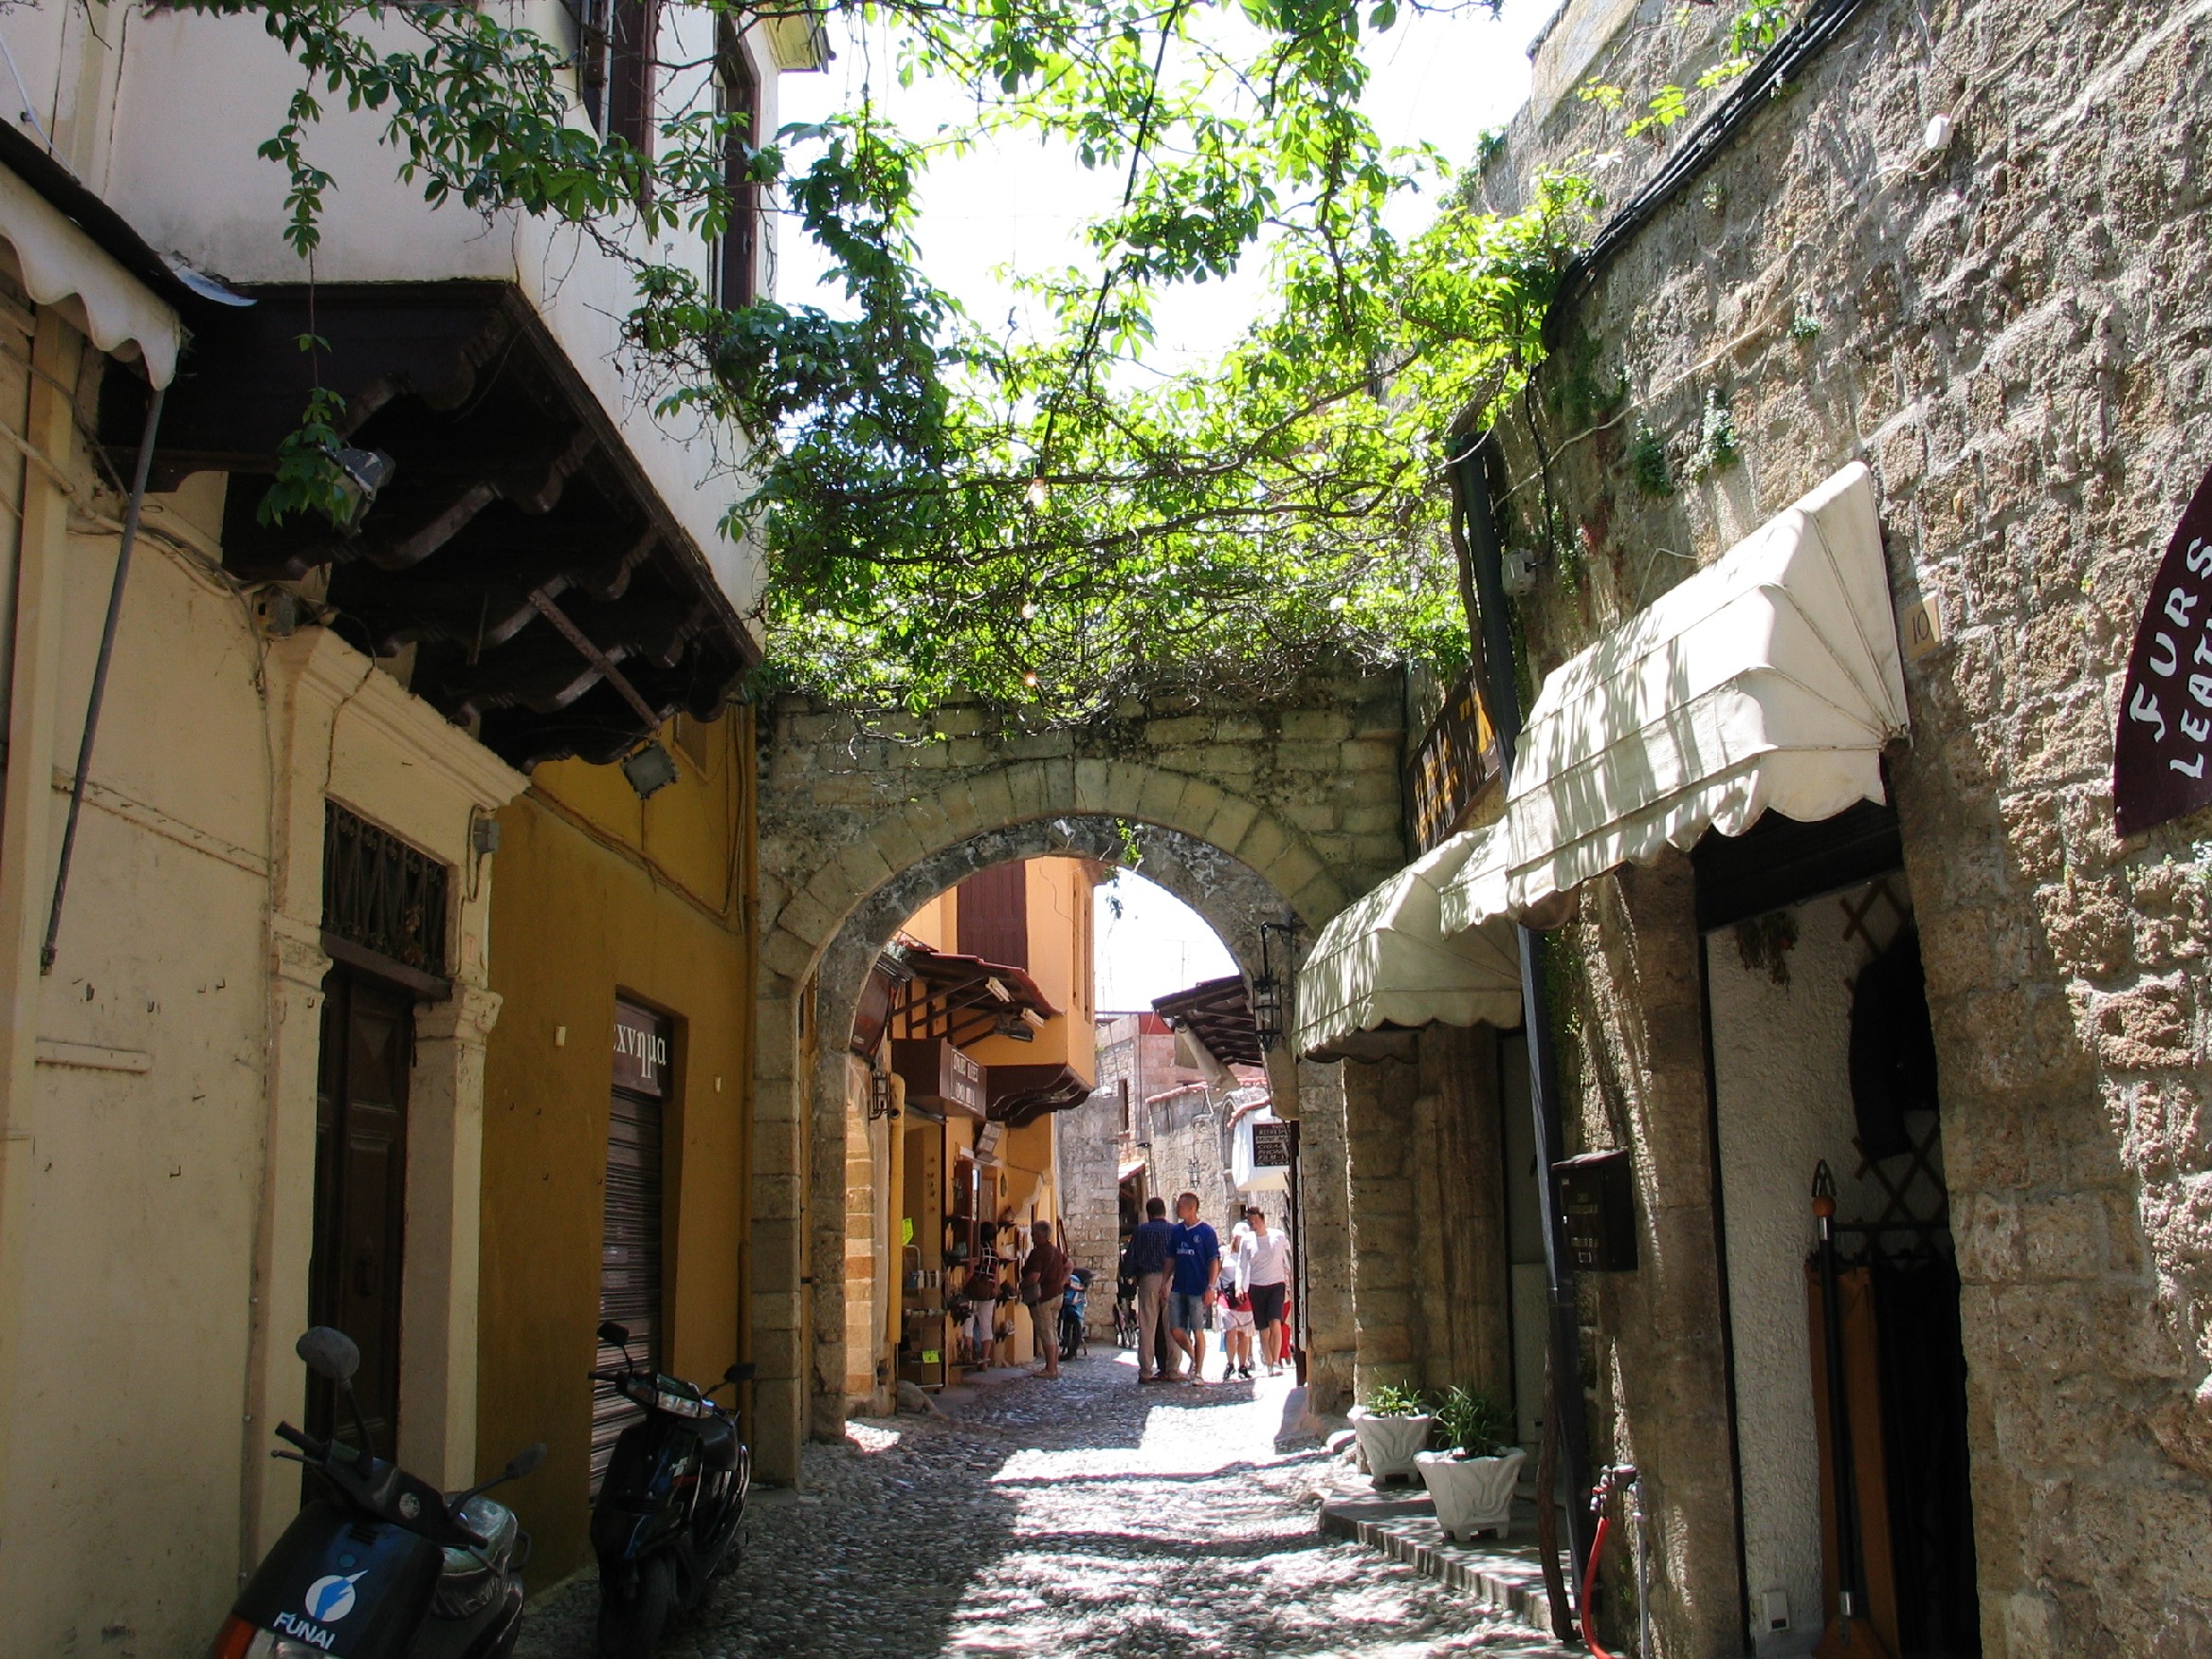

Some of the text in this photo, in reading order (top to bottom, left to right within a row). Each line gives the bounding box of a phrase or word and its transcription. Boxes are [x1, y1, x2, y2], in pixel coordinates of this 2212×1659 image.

[1911, 610, 1929, 645] 10
[2130, 537, 2212, 742] FURS
[2169, 618, 2212, 779] LEAT
[613, 1023, 667, 1079] χνημα
[273, 1612, 335, 1650] FUNAI
